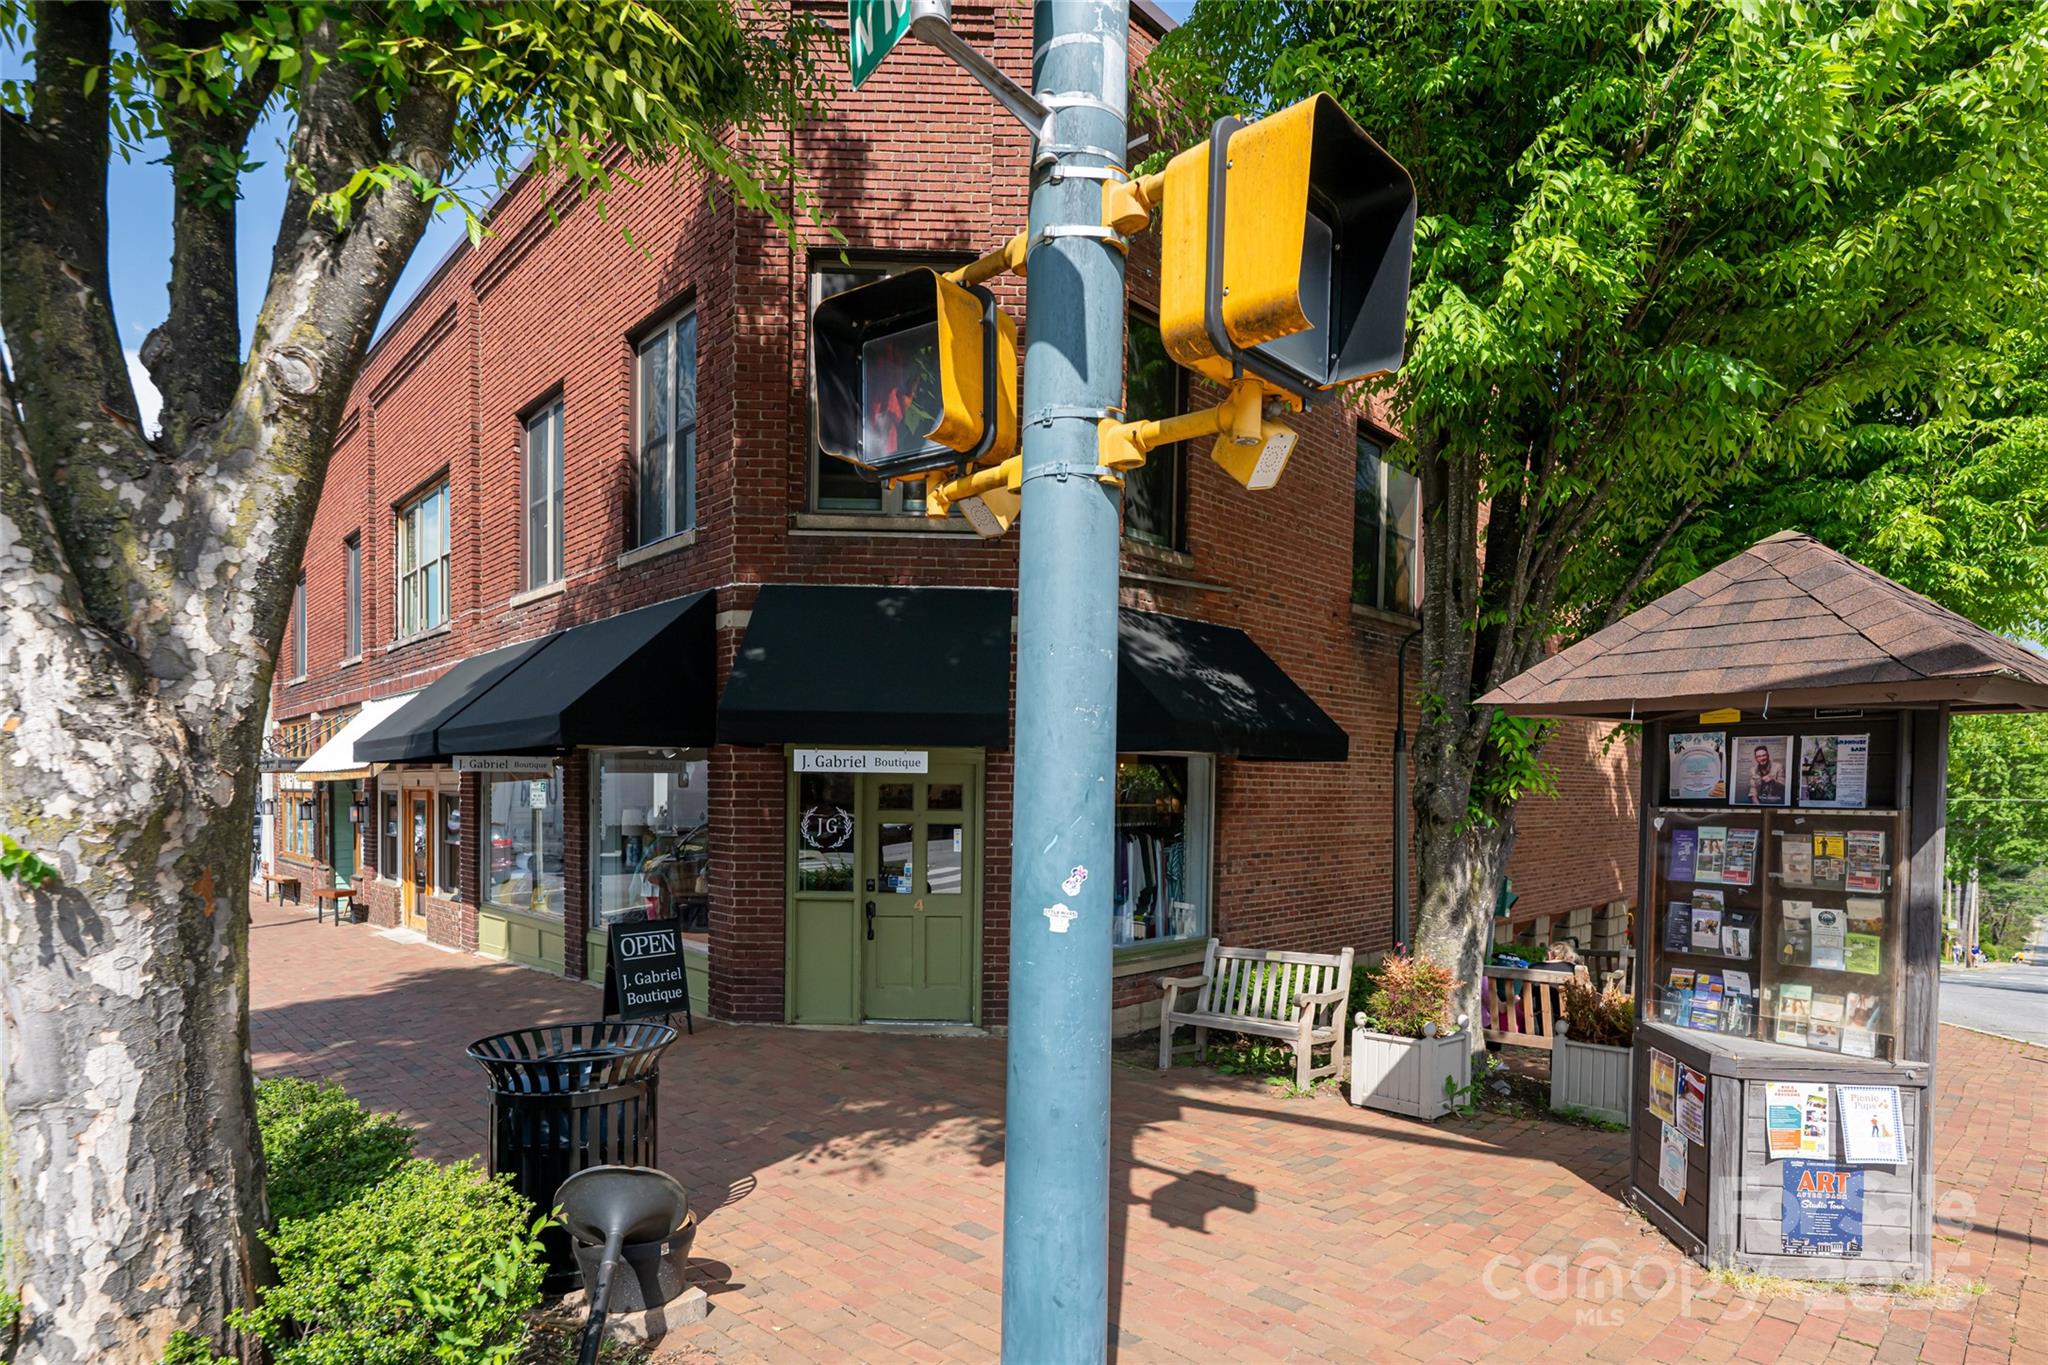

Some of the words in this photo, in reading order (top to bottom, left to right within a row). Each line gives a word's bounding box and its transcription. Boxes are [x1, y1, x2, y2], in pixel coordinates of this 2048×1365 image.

[469, 759, 508, 769] Gabriel
[514, 760, 548, 770] Boutique
[802, 755, 810, 770] J.
[815, 754, 867, 769] Gabriel
[874, 757, 921, 770] Boutique
[914, 899, 925, 912] 4
[620, 932, 676, 957] OPEN
[622, 974, 632, 990] J.
[634, 967, 682, 986] Gabriel
[626, 988, 683, 1006] Boutique
[1850, 1093, 1880, 1103] Picnic
[1854, 1101, 1877, 1111] Pups
[1797, 1170, 1850, 1194] ART
[1801, 1199, 1827, 1209] Studio
[1827, 1200, 1845, 1210] Tour
